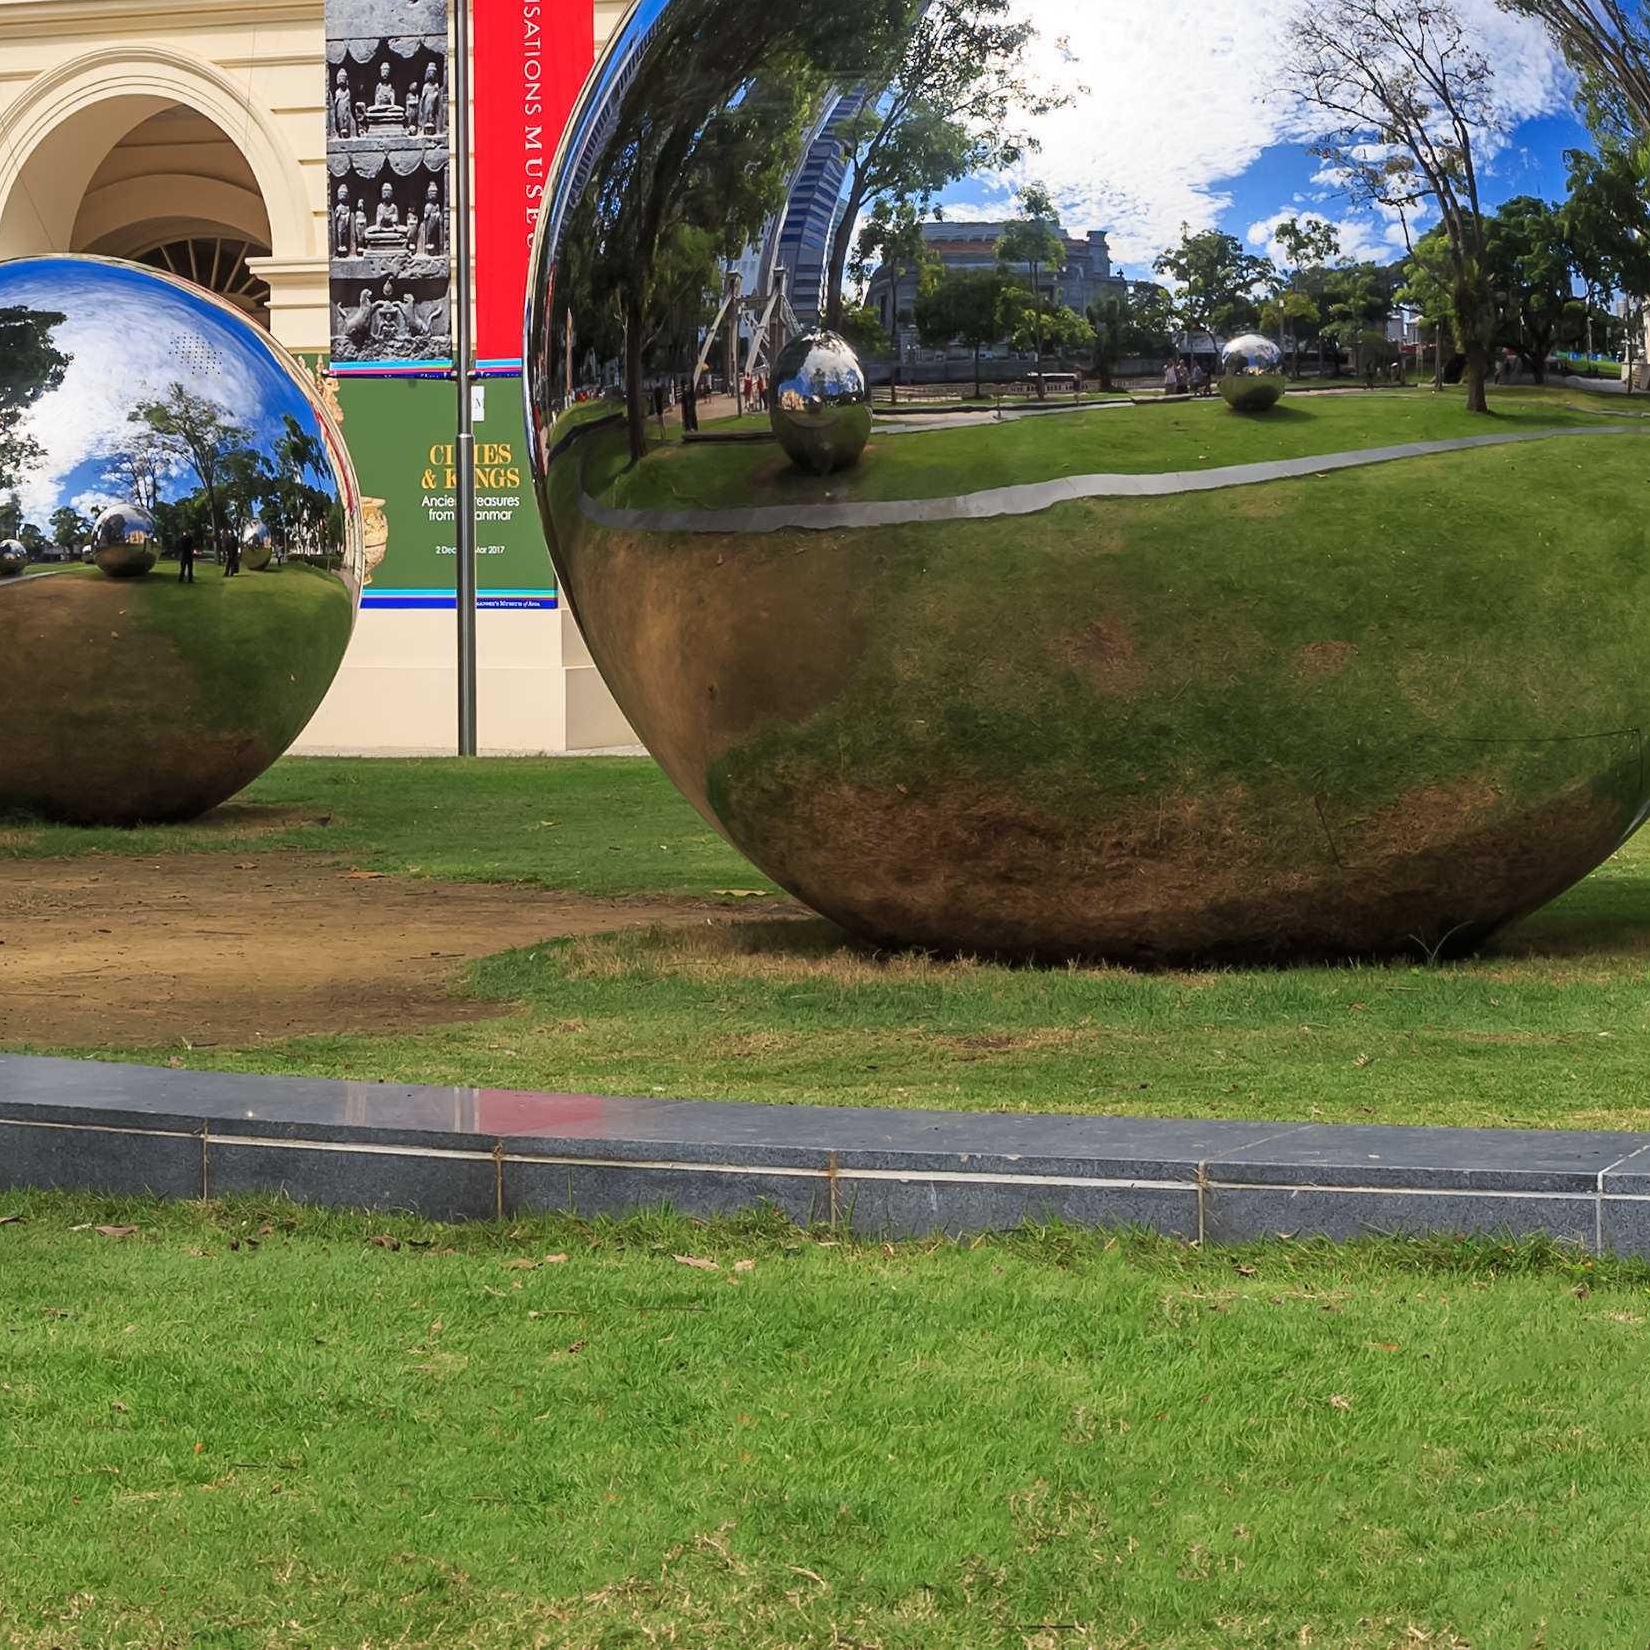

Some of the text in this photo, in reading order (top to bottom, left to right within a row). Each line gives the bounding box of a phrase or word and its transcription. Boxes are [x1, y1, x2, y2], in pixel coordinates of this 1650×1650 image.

[429, 443, 512, 466] CIIES
[421, 467, 520, 489] & KNGS
[429, 508, 455, 521] from
